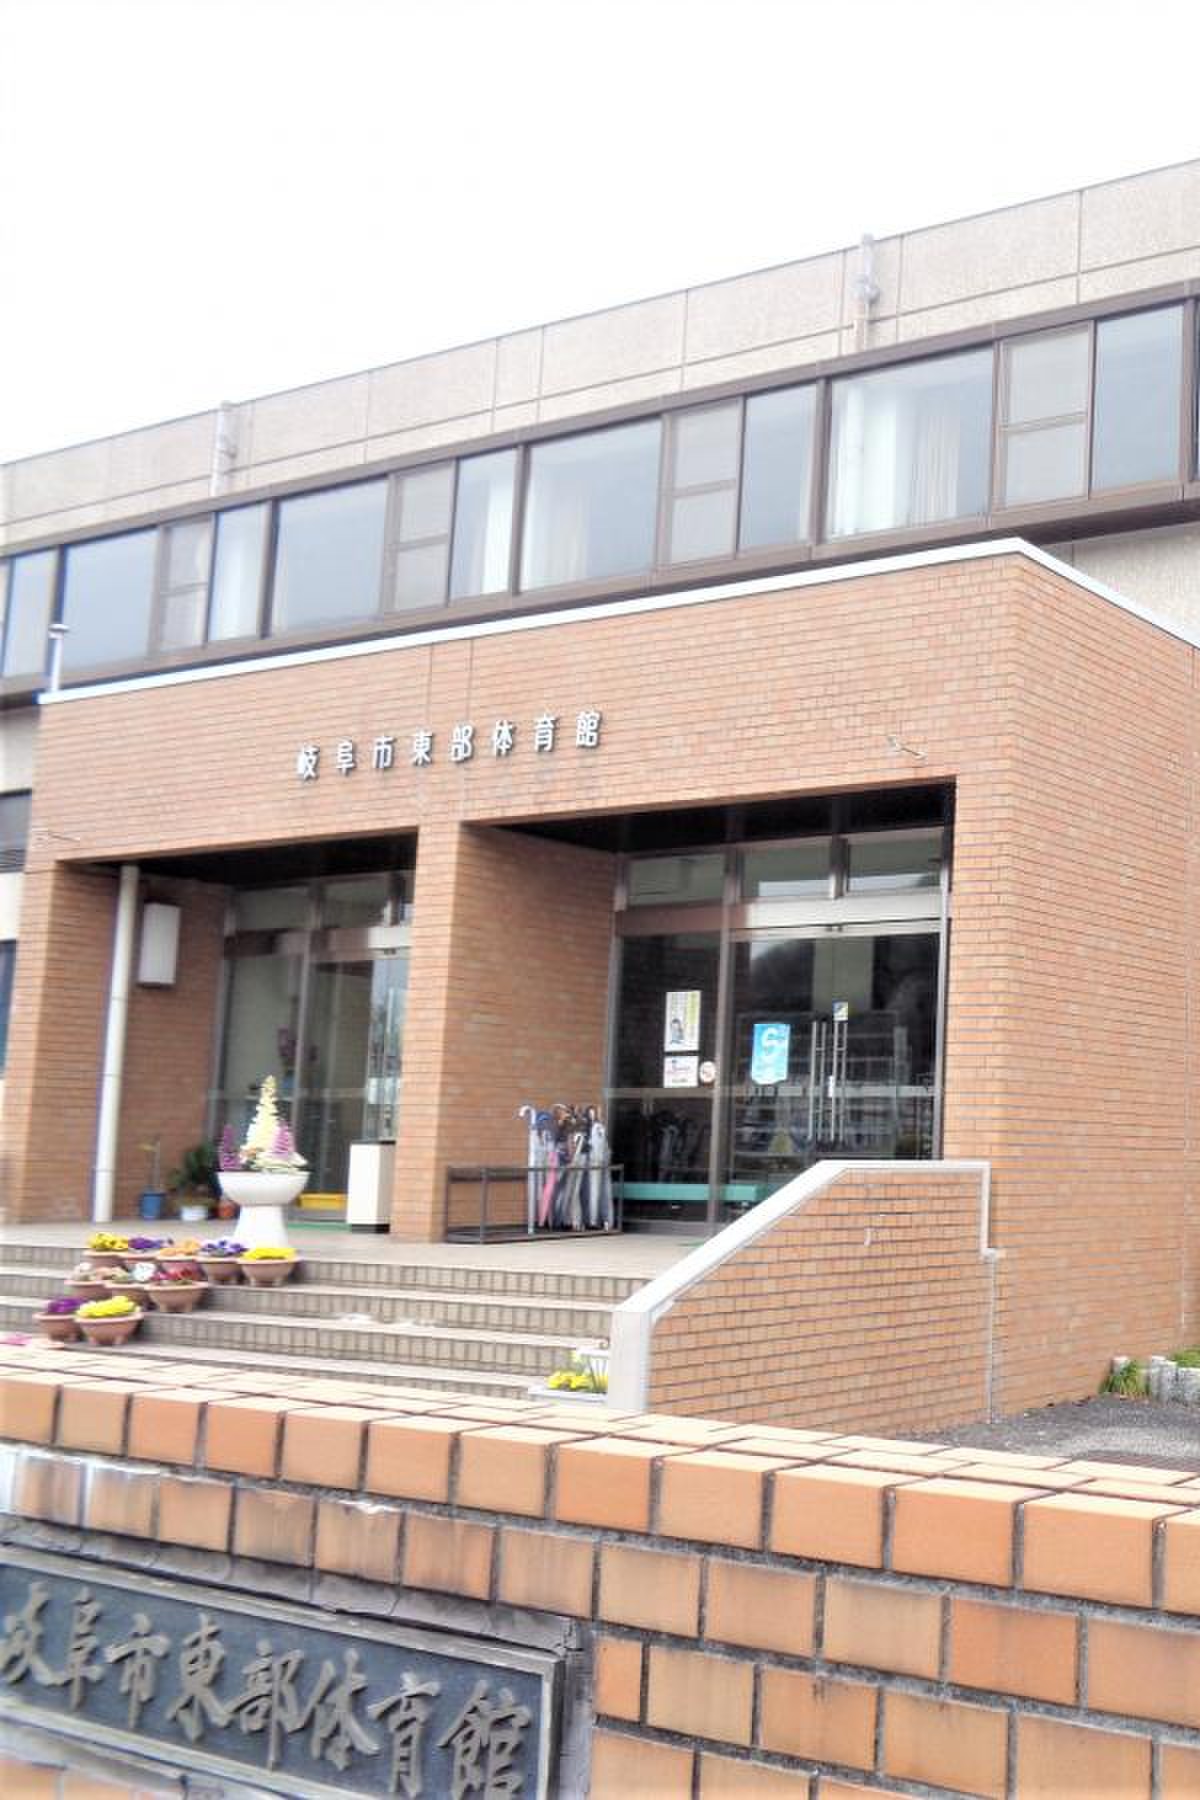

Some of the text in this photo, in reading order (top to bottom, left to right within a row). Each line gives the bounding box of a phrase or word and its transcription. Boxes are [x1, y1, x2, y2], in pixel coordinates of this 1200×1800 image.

[296, 709, 601, 780] 岐阜市東部体育館
